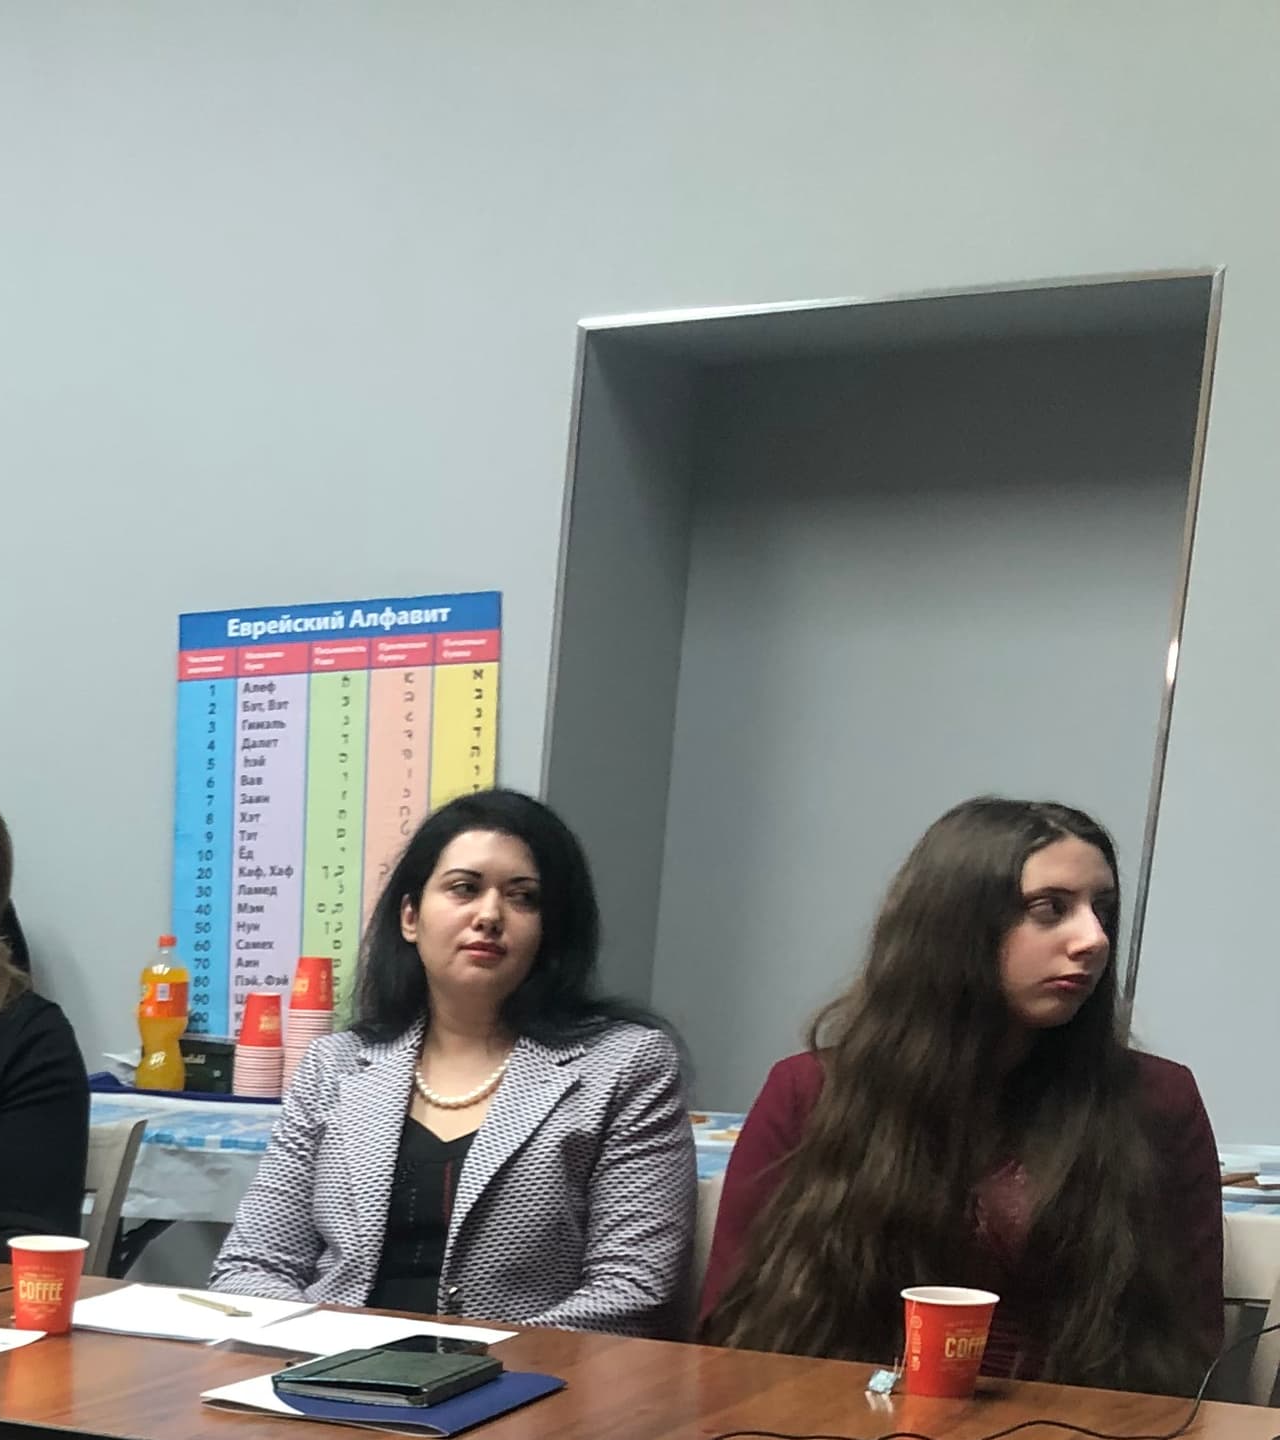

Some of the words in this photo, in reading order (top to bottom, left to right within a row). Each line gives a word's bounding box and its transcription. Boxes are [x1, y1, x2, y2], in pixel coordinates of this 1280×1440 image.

[227, 610, 344, 640] Еврейский
[349, 607, 451, 631] Алфавит
[242, 682, 276, 694] Алеф
[241, 738, 278, 751] Далет
[241, 775, 263, 786] Вав
[197, 849, 213, 862] 10
[196, 867, 212, 879] 20
[195, 885, 212, 898] 30
[195, 904, 211, 916] 40
[195, 922, 211, 934] 50
[194, 940, 211, 952] 60
[194, 958, 210, 970] 70
[193, 976, 209, 988] 80
[193, 994, 209, 1005] 90
[18, 1279, 64, 1302] COFFEE
